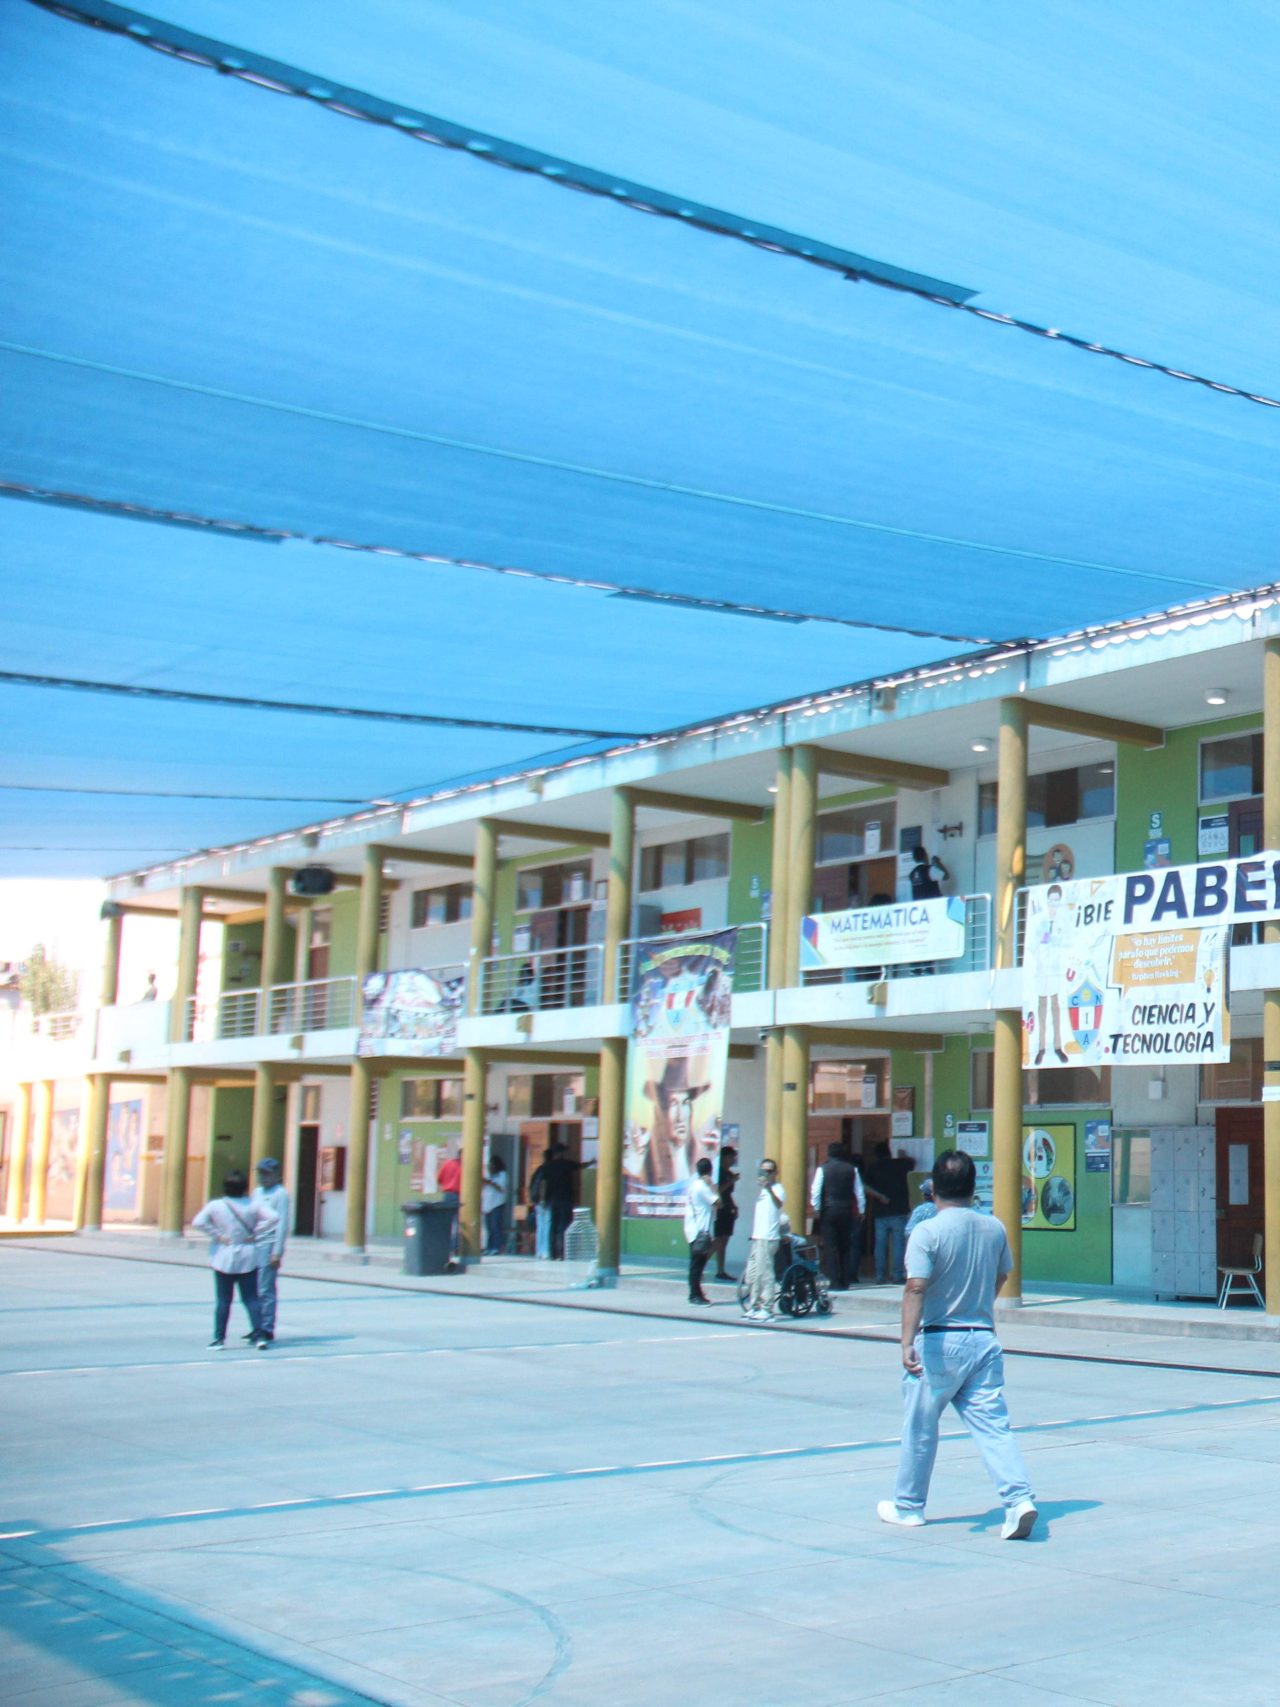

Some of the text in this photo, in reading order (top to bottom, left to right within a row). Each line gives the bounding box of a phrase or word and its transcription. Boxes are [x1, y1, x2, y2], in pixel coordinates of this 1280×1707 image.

[1151, 814, 1161, 828] S
[830, 906, 930, 934] MATEMATICA
[1132, 1002, 1215, 1026] CIENCIA Y
[1109, 1022, 1215, 1055] TECNOLOGÍA
[945, 1114, 953, 1127] S
